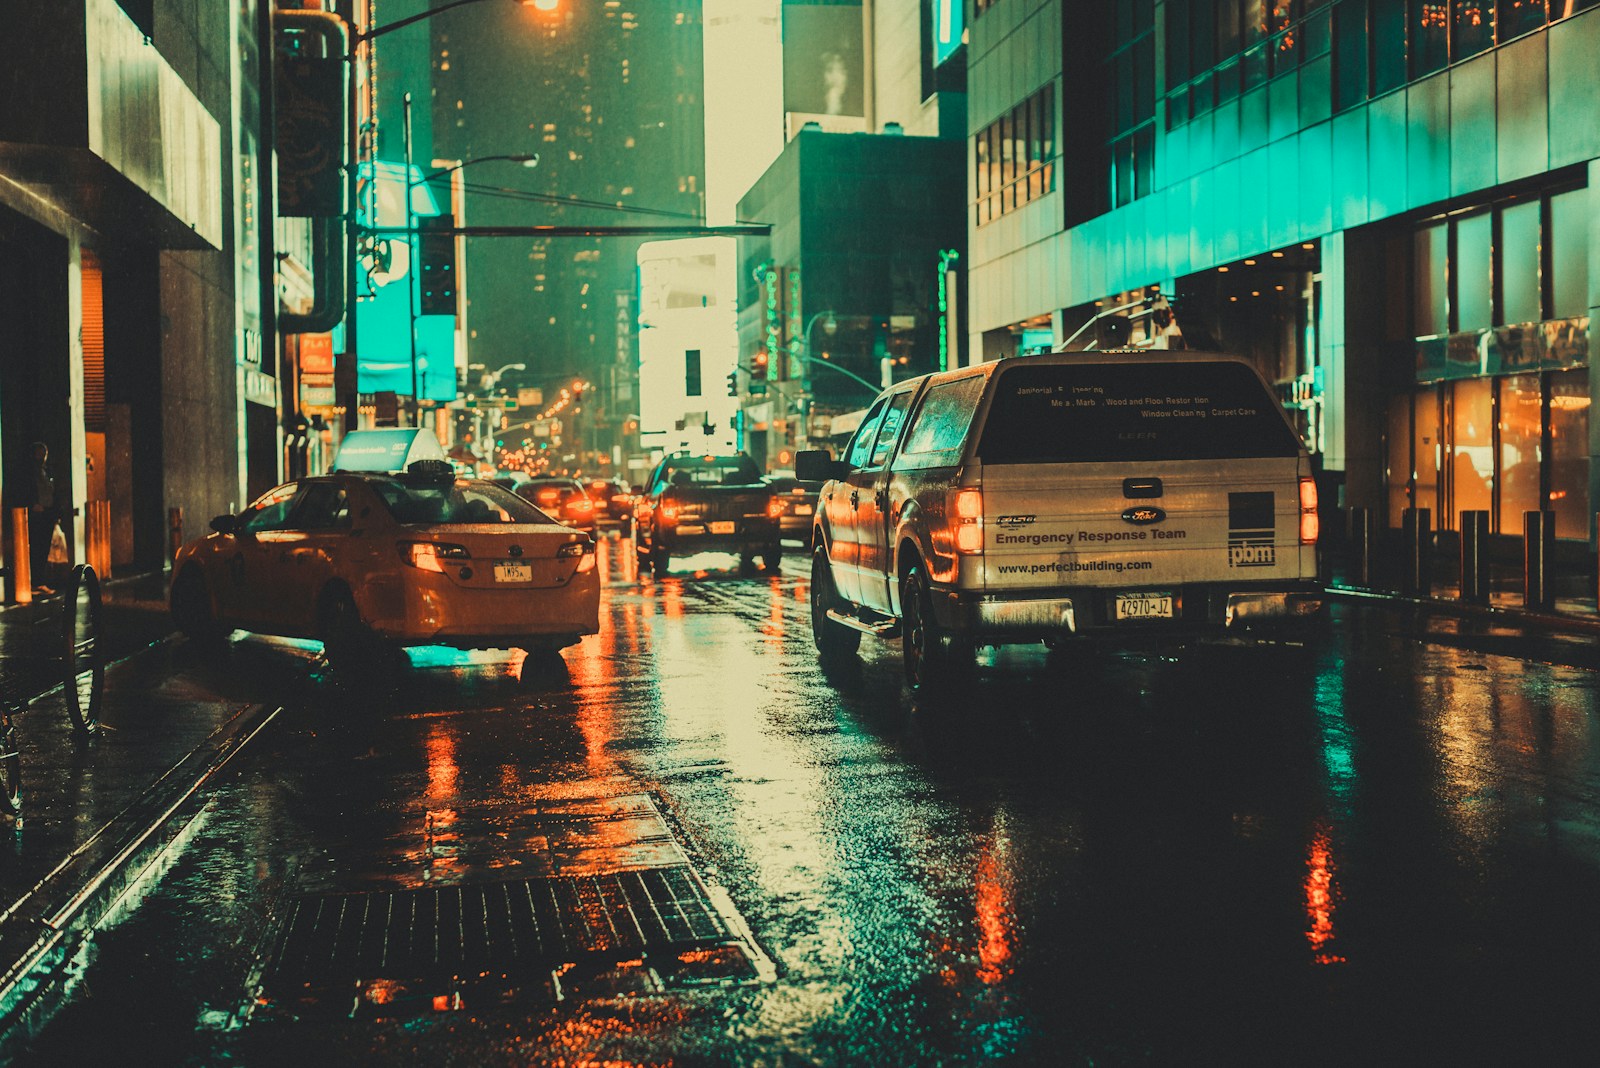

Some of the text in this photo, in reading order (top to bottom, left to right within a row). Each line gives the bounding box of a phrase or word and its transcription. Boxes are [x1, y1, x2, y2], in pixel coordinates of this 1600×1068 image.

[1106, 398, 1128, 406] Wood
[1141, 410, 1171, 418] Window
[1211, 408, 1237, 417] Carpet
[996, 529, 1186, 545] Emergency Response Team
[998, 561, 1152, 575] www.perfectbuilding.com
